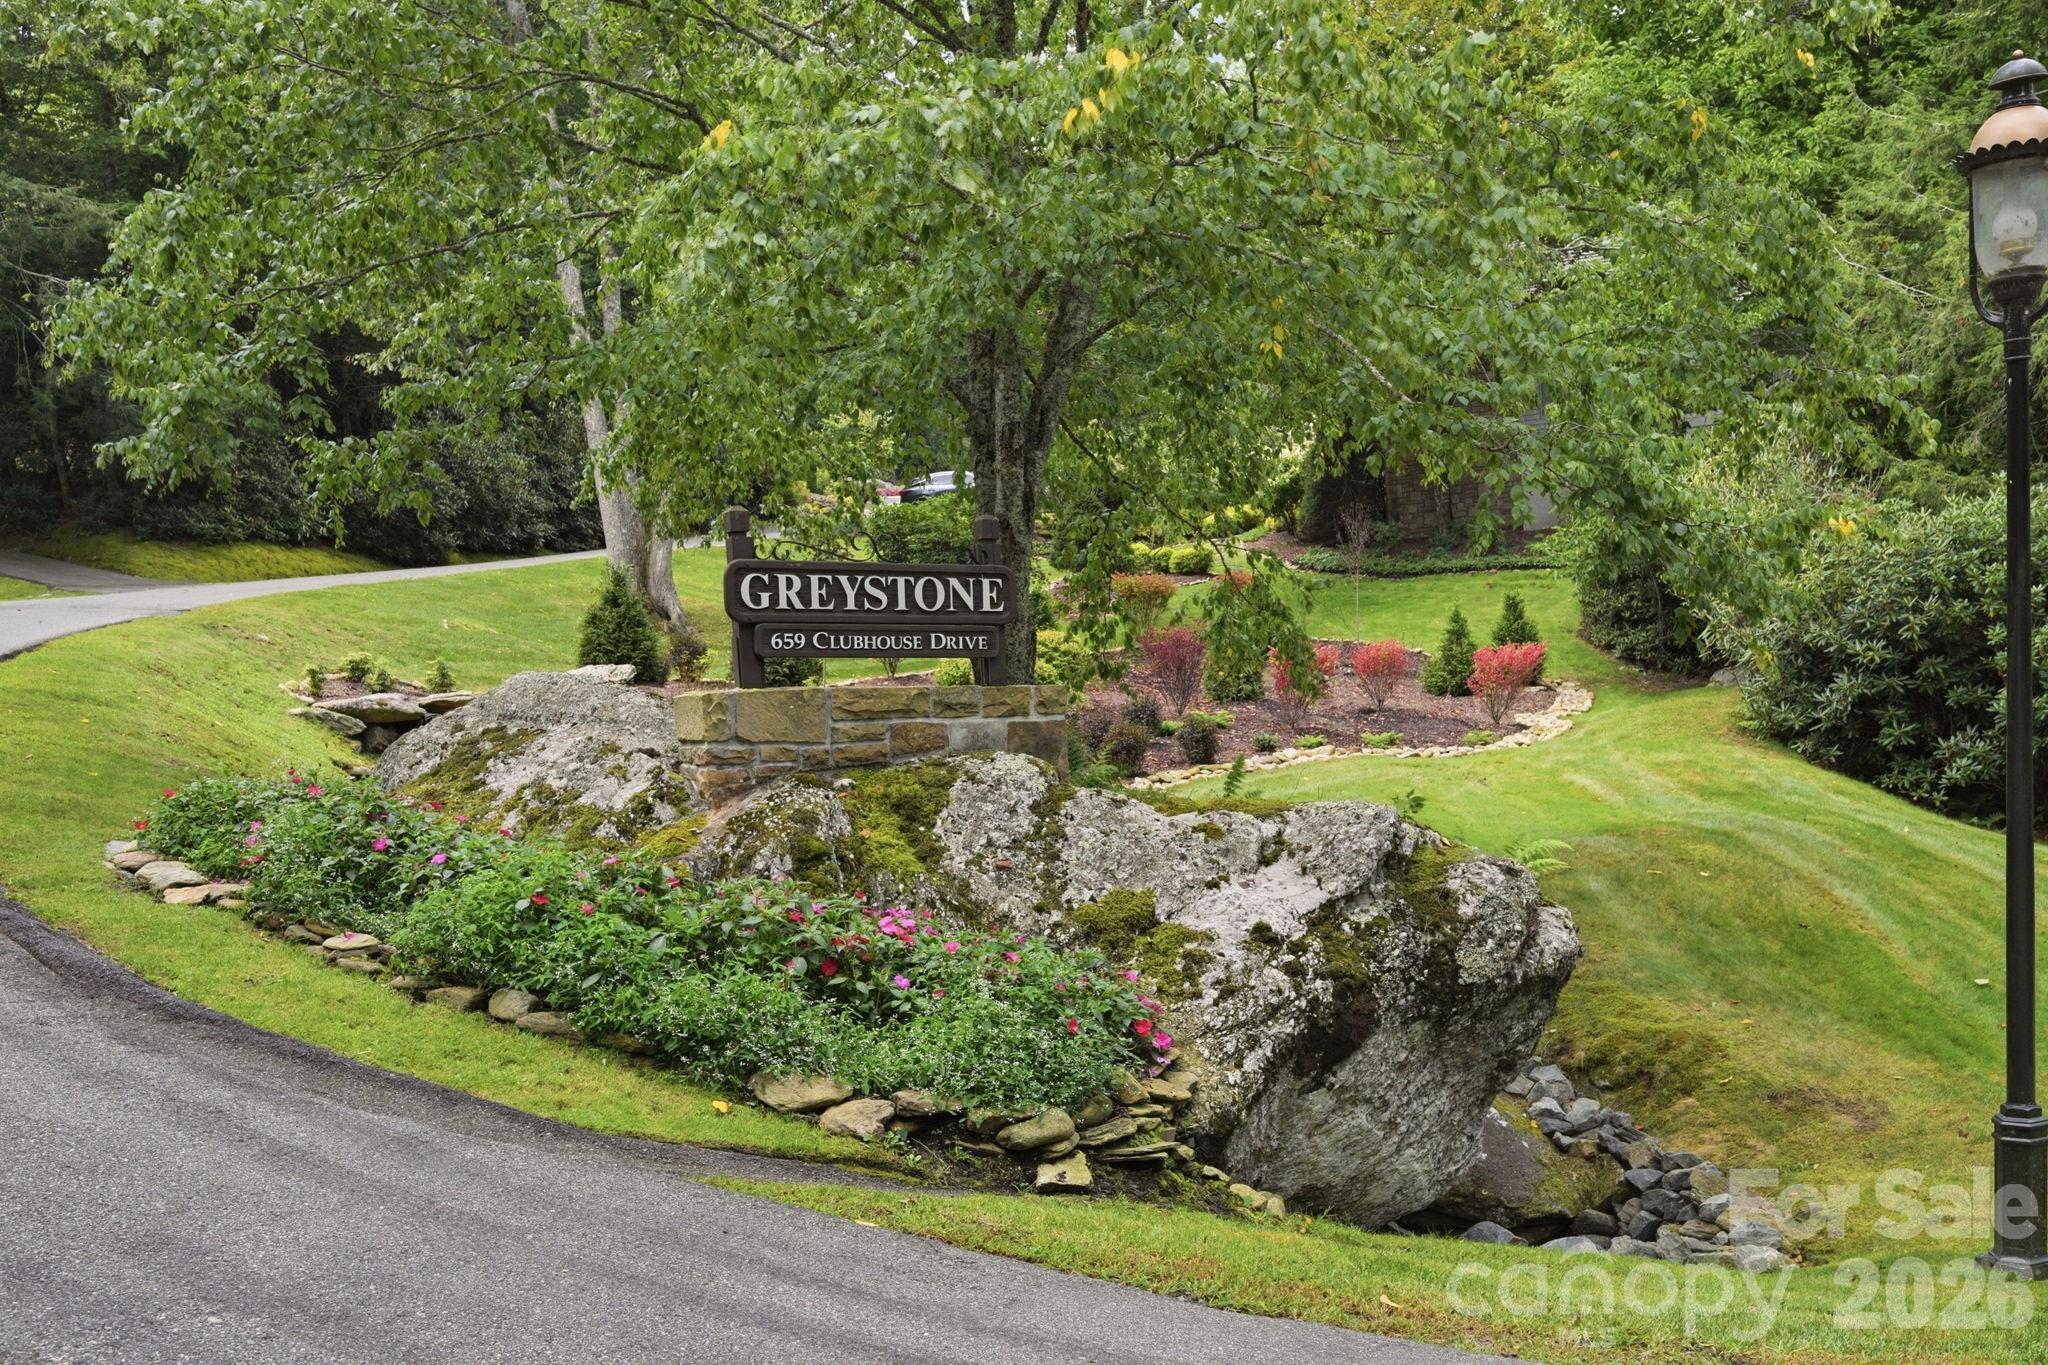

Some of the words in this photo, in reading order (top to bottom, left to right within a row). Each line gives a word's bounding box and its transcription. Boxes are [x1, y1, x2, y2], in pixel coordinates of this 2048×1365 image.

[740, 573, 1005, 612] GREYSTONE
[770, 632, 806, 650] 659
[812, 632, 923, 650] CLUBHOUSE
[929, 632, 988, 651] DRIVE
